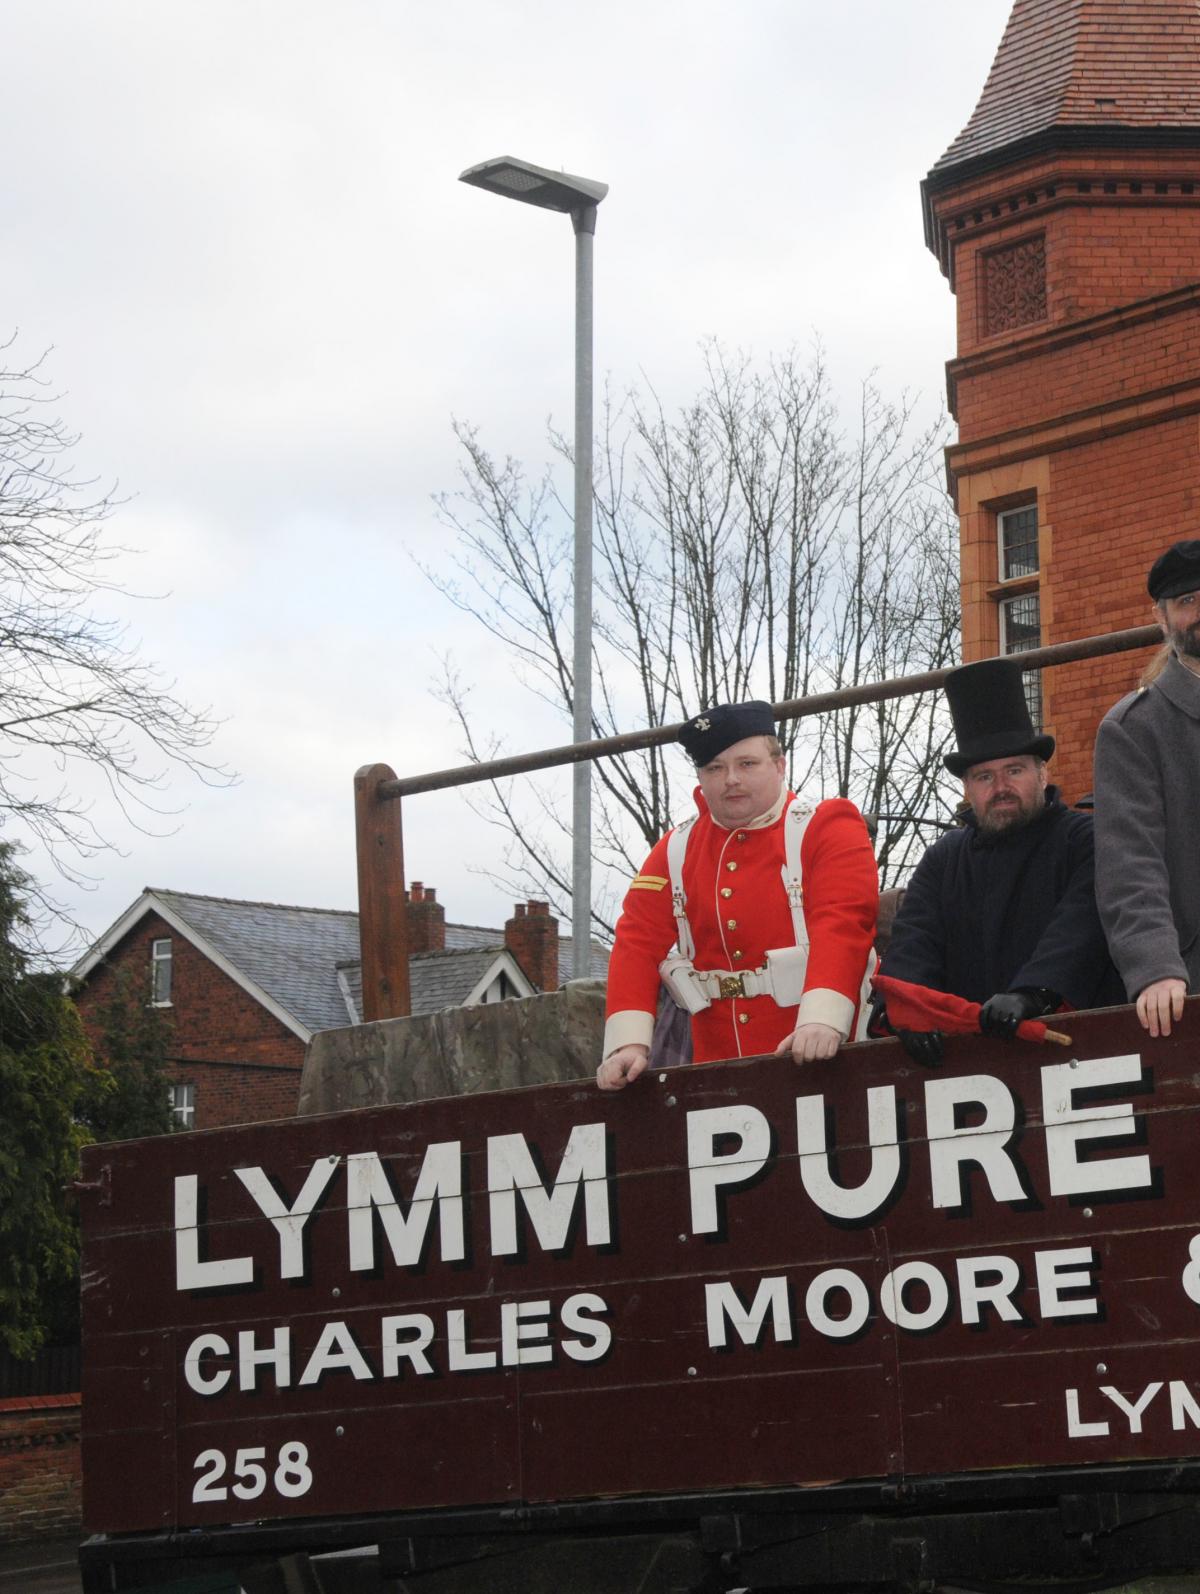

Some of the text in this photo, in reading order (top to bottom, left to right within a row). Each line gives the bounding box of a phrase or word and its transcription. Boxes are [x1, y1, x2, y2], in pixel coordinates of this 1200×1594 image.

[174, 1123, 611, 1291] LYMM
[686, 1054, 1151, 1235] PURE
[183, 1293, 612, 1396] CHARLES
[704, 1246, 1099, 1348] MOORE
[192, 1441, 313, 1503] 258
